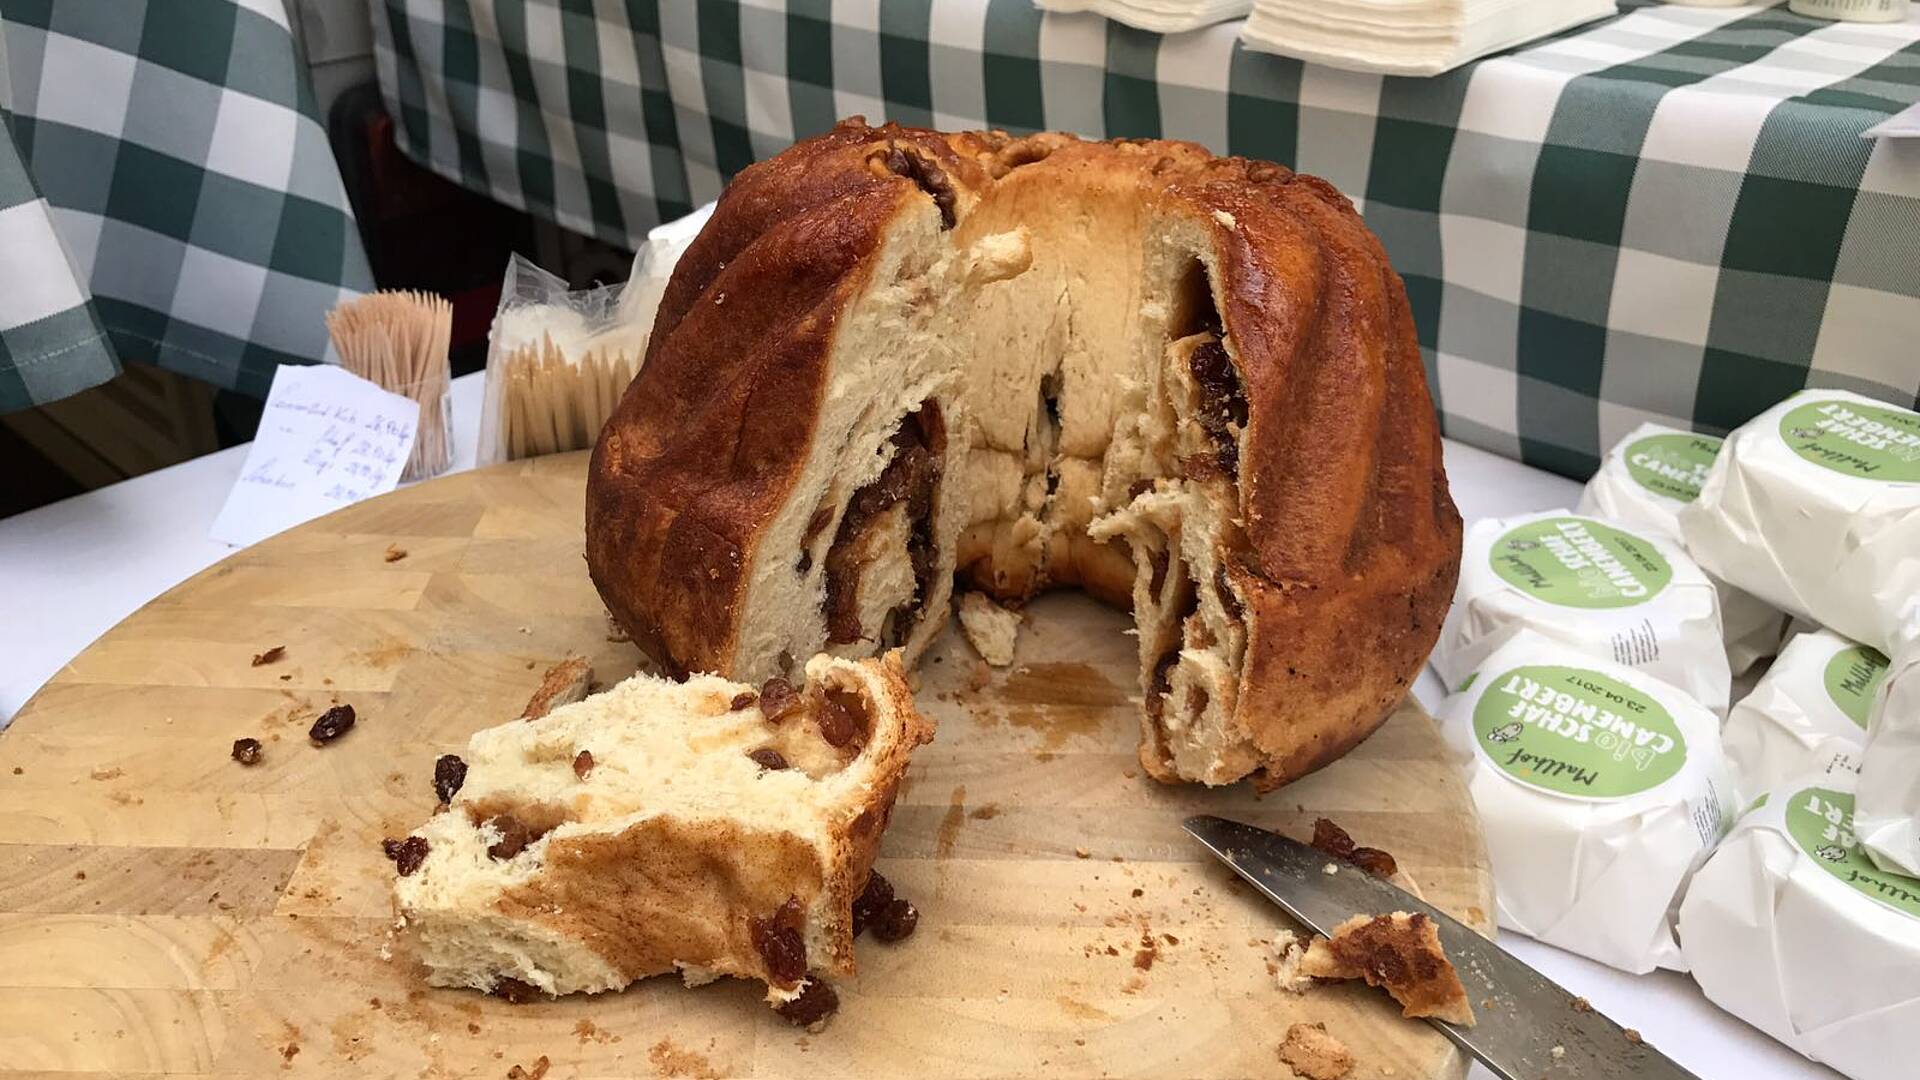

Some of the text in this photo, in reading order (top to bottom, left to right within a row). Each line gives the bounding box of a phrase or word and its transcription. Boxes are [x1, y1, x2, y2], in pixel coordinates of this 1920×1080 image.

[1539, 534, 1592, 570] SCHAF
[1556, 522, 1647, 597] CAMEMBERT
[1500, 674, 1675, 753] CAMEMBERT
[1566, 675, 1646, 714] 23.04.2017
[1507, 699, 1657, 771] bio SCHAF
[1506, 748, 1599, 786] Mallhof
